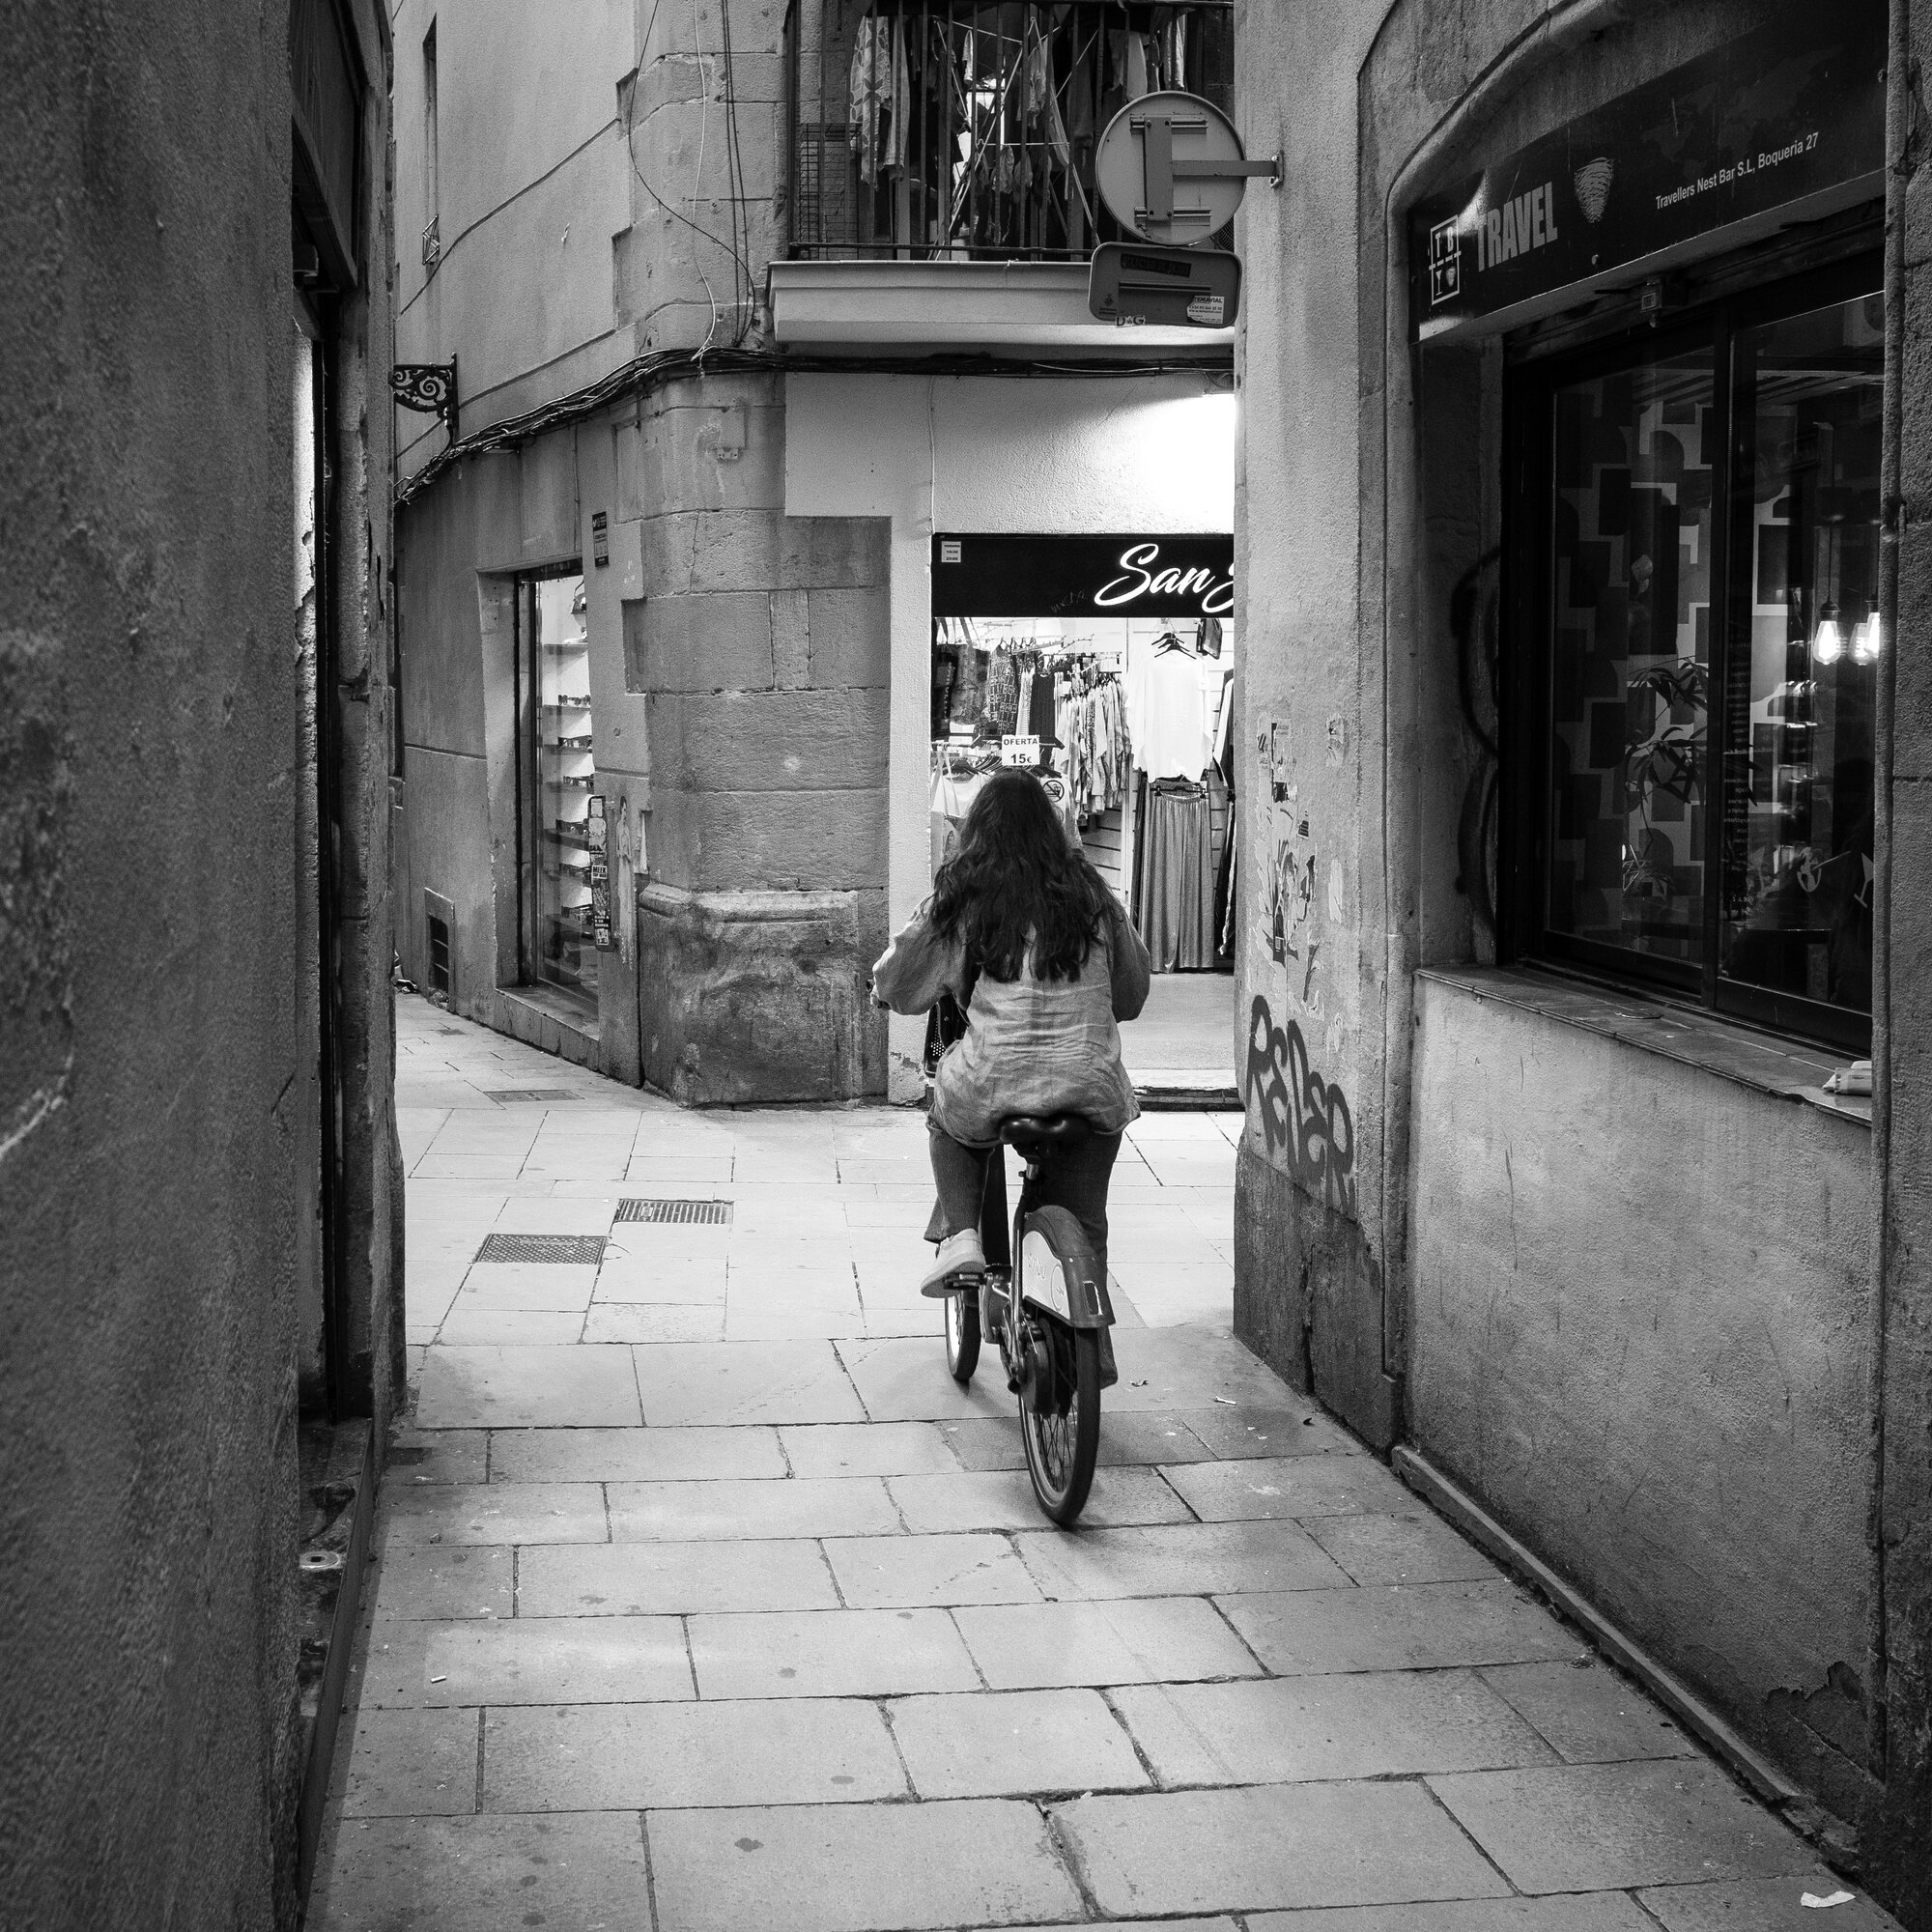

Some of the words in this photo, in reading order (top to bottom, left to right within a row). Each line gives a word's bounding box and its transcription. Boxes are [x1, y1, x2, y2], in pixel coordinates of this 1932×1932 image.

[1655, 184, 1695, 209] Travellers
[1696, 172, 1718, 193] Nest
[1719, 167, 1735, 185] Bar
[1758, 139, 1804, 169] Boqueria
[1805, 130, 1820, 152] 27
[1476, 182, 1558, 272] TRAVEL
[1094, 543, 1216, 607] San
[1010, 753, 1033, 764] 15€
